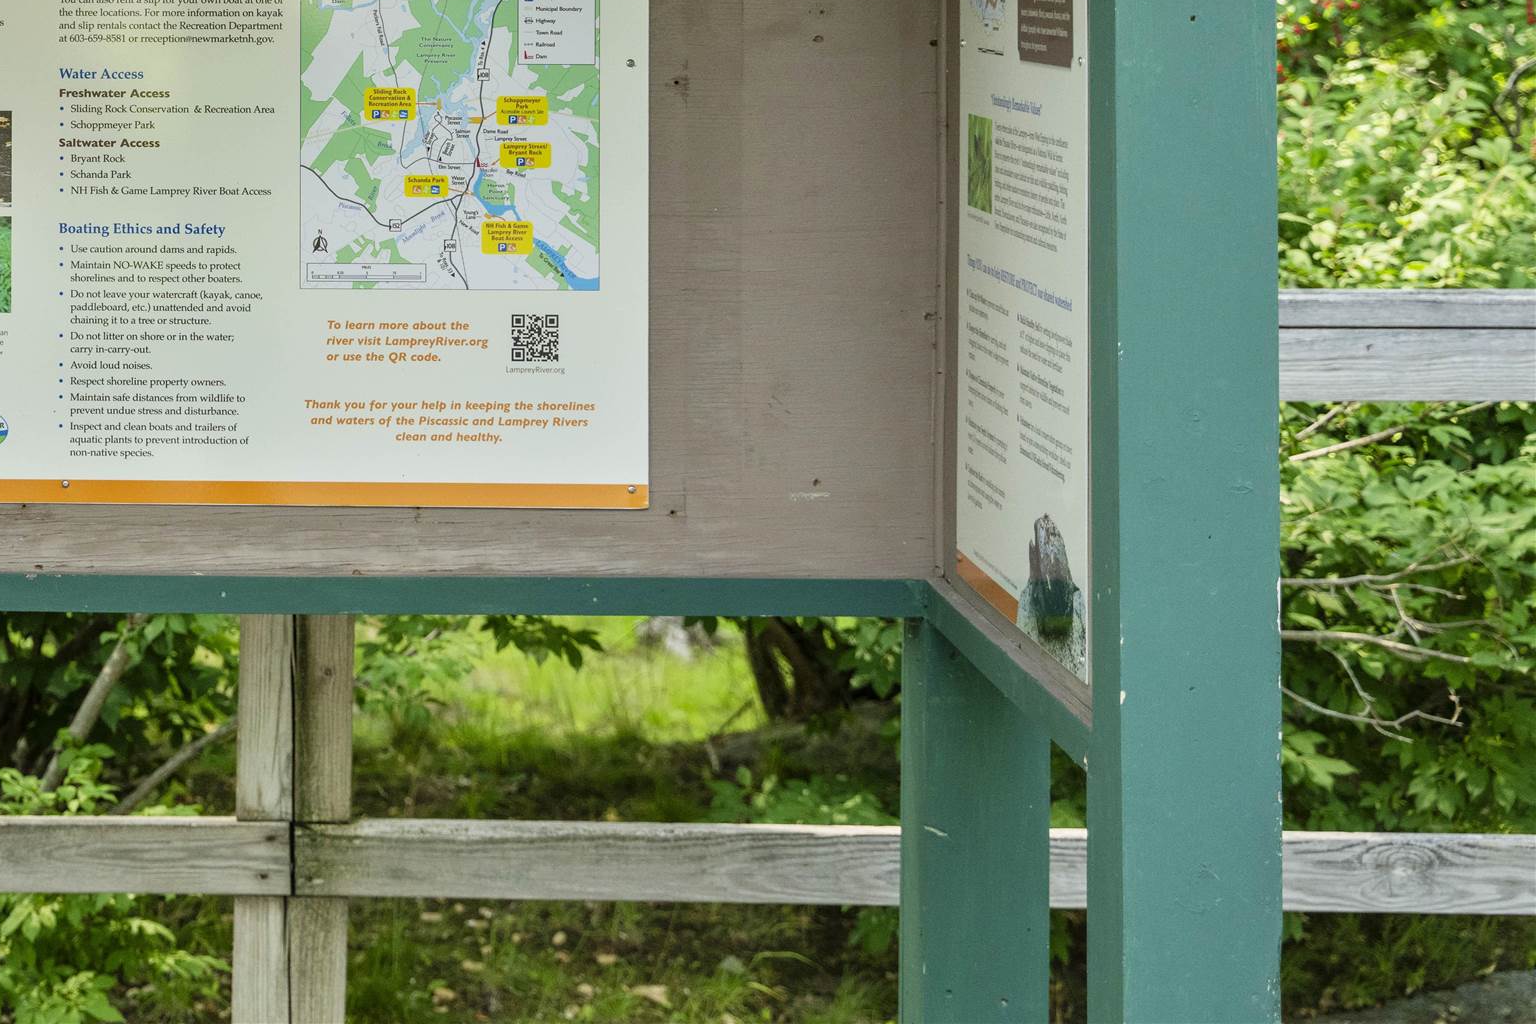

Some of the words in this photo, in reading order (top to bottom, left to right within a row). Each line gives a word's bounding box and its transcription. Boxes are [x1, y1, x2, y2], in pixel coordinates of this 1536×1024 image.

[59, 68, 97, 79] Water
[100, 68, 144, 80] Access
[59, 88, 126, 98] Freshwater
[130, 89, 170, 98] Access
[59, 138, 117, 148] Saltwater
[120, 138, 160, 148] Access
[71, 154, 101, 164] Bryant
[103, 154, 125, 163] Rock
[71, 186, 87, 195] NH
[90, 185, 109, 195] Fish
[110, 186, 119, 195] &
[121, 186, 148, 195] Game
[150, 186, 191, 197] Lamprey
[193, 186, 217, 196] River
[219, 187, 239, 195] Boat
[241, 187, 272, 196] Access
[59, 223, 110, 237] Boating
[113, 223, 153, 234] Ethics
[156, 223, 180, 234] and
[185, 223, 226, 237] Safety
[327, 320, 341, 330] To
[345, 320, 375, 330] learn
[379, 322, 409, 330] more
[412, 321, 446, 330] about
[450, 321, 470, 331] the
[326, 336, 354, 346] river
[357, 336, 381, 346] visit
[385, 336, 488, 349] LampreyRiver.org
[366, 352, 385, 362] the
[388, 352, 407, 364] QR
[410, 352, 441, 362] code.
[70, 360, 97, 369] Avoid
[100, 361, 120, 370] loud
[122, 361, 153, 370] noises.
[506, 366, 565, 375] LampreyRiver.org
[395, 432, 427, 441] clean
[430, 432, 453, 442] and
[456, 432, 502, 444] healthy.
[70, 448, 118, 457] non-native
[120, 448, 154, 459] species.
